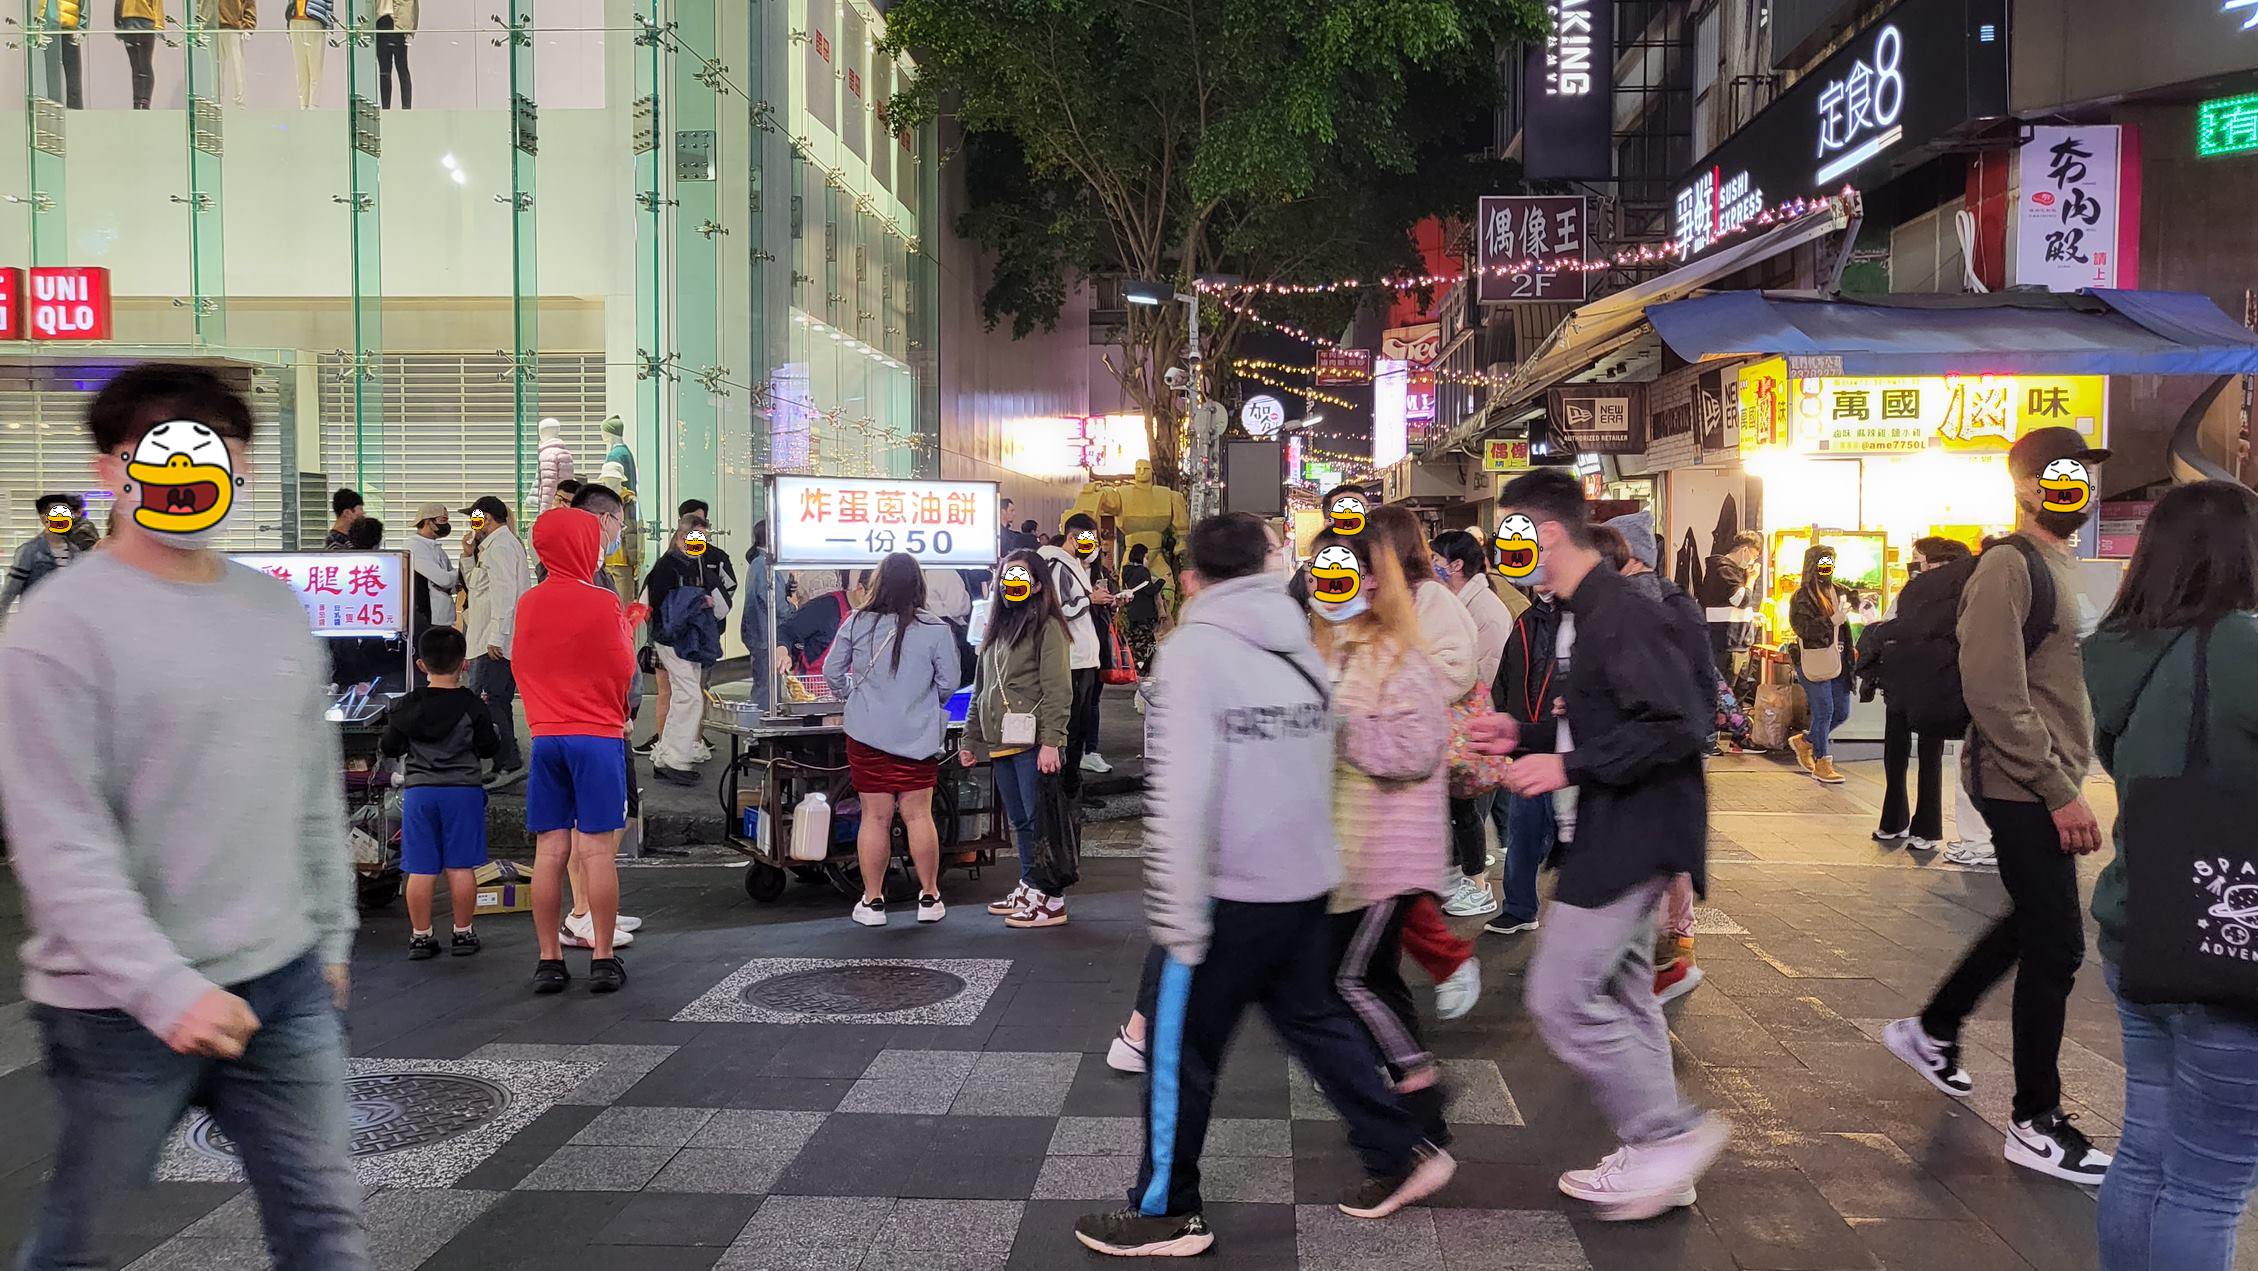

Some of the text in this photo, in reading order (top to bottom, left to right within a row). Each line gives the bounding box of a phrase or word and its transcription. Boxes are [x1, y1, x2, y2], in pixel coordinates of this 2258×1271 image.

[1817, 25, 1903, 158] 定食8
[1719, 169, 1749, 209] SUSHI
[1676, 171, 1714, 262] 爭鮮
[1718, 187, 1764, 236] EXPRESS
[1485, 204, 1580, 259] 偶像王
[35, 275, 89, 301] UNI
[1511, 273, 1557, 297] 2F
[36, 305, 94, 335] QLO
[1725, 381, 1738, 405] NE
[1601, 405, 1624, 415] NEW
[1601, 415, 1624, 424] ERA
[800, 487, 976, 526] 炸蛋蔥油餅
[825, 528, 954, 554] 一份50
